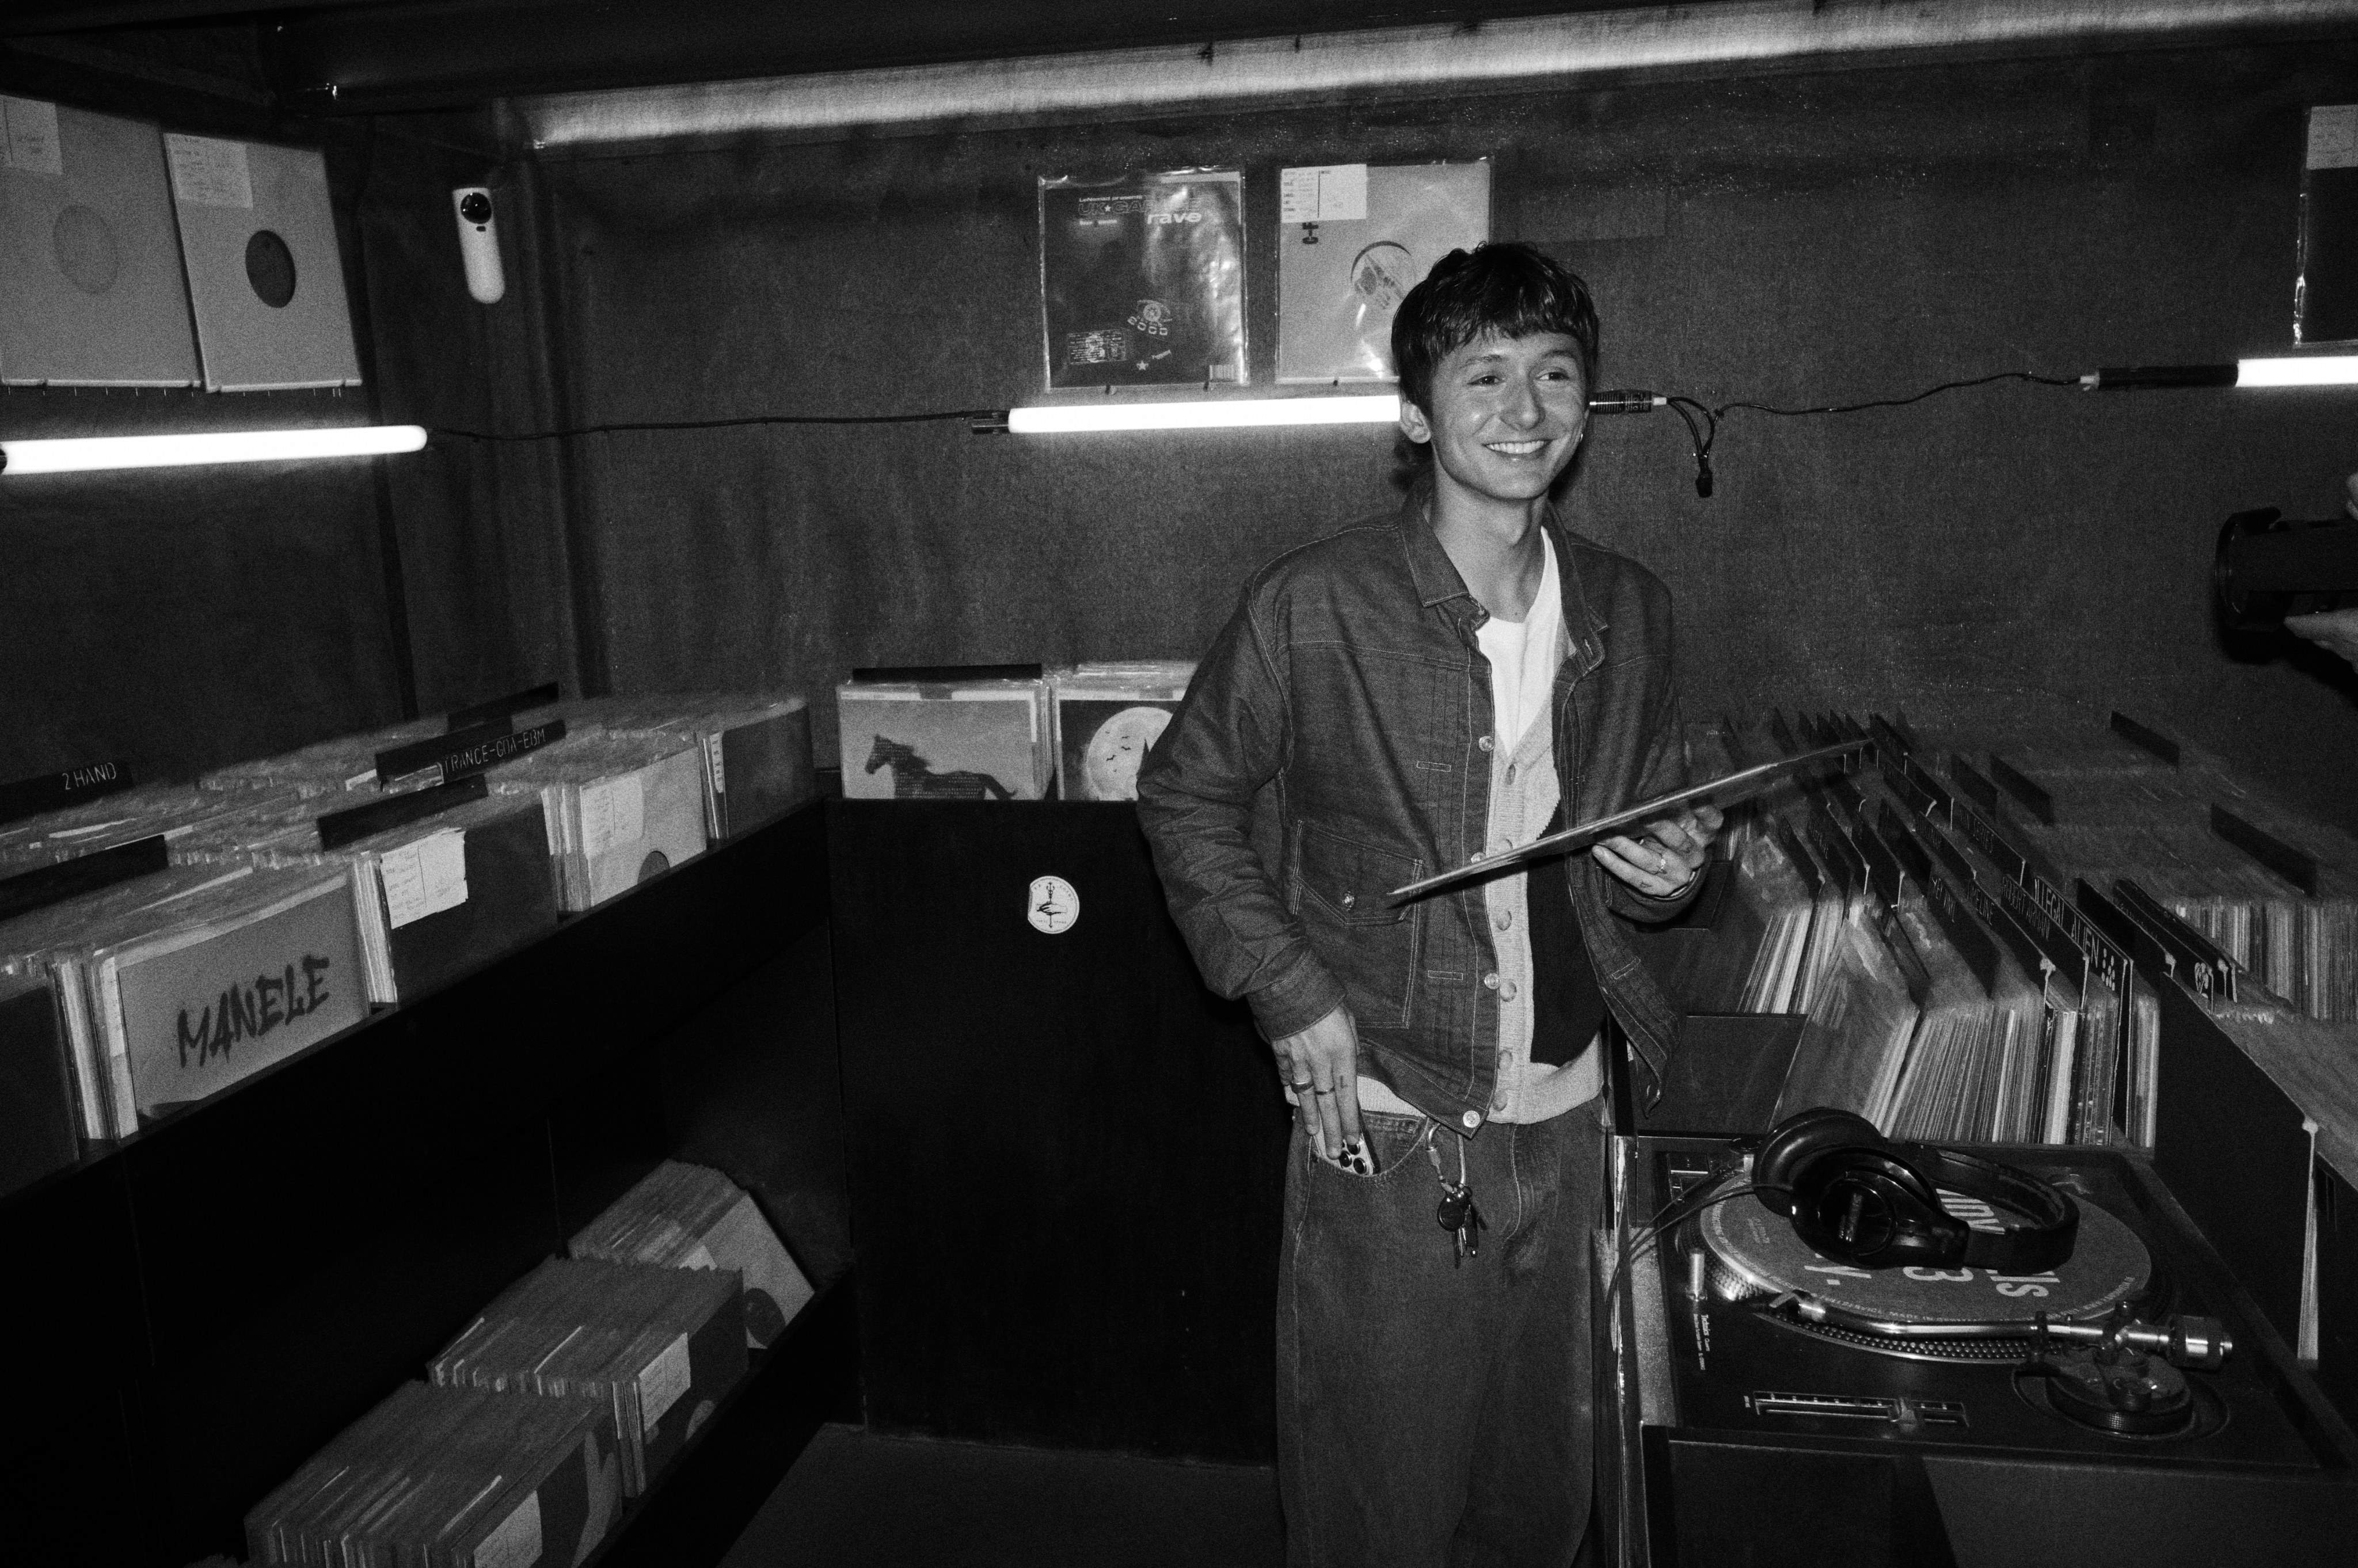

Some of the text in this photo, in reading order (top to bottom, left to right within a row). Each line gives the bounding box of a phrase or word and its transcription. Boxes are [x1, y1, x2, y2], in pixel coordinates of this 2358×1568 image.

[1147, 212, 1202, 224] rave
[62, 761, 117, 790] 2 HAND
[2070, 913, 2100, 969] ALIEN
[176, 953, 330, 1069] MANELE
